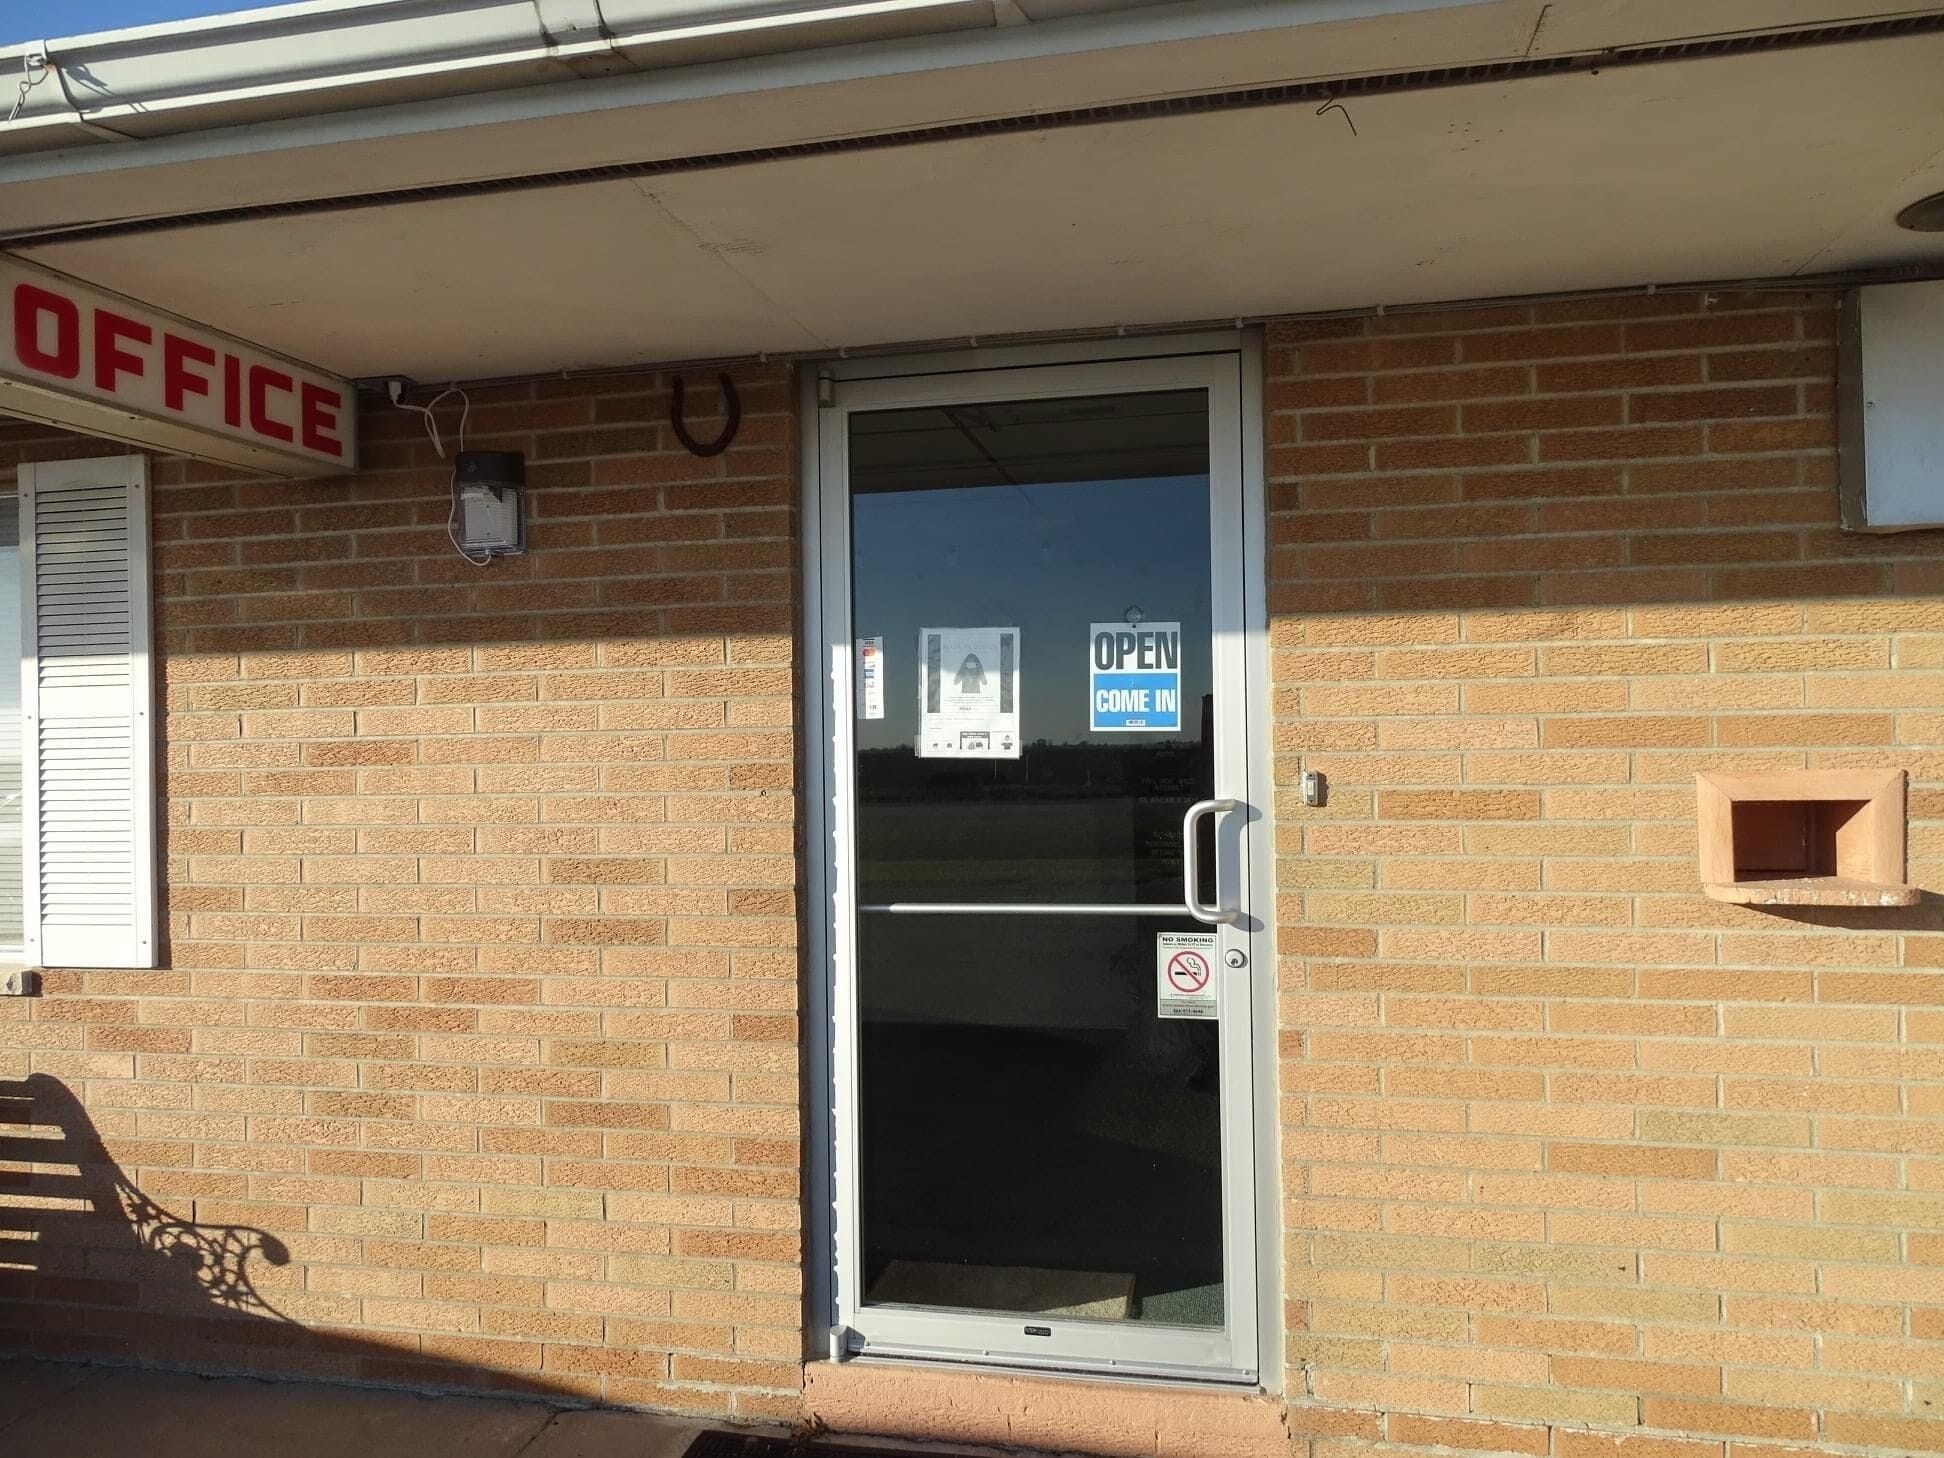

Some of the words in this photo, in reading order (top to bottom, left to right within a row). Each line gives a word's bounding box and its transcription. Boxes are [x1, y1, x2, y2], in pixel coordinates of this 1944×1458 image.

[14, 283, 342, 457] OFFICE
[1094, 631, 1178, 671] OPEN
[1096, 688, 1150, 713] COME
[1155, 688, 1176, 713] IN
[1176, 936, 1214, 944] SMOKING
